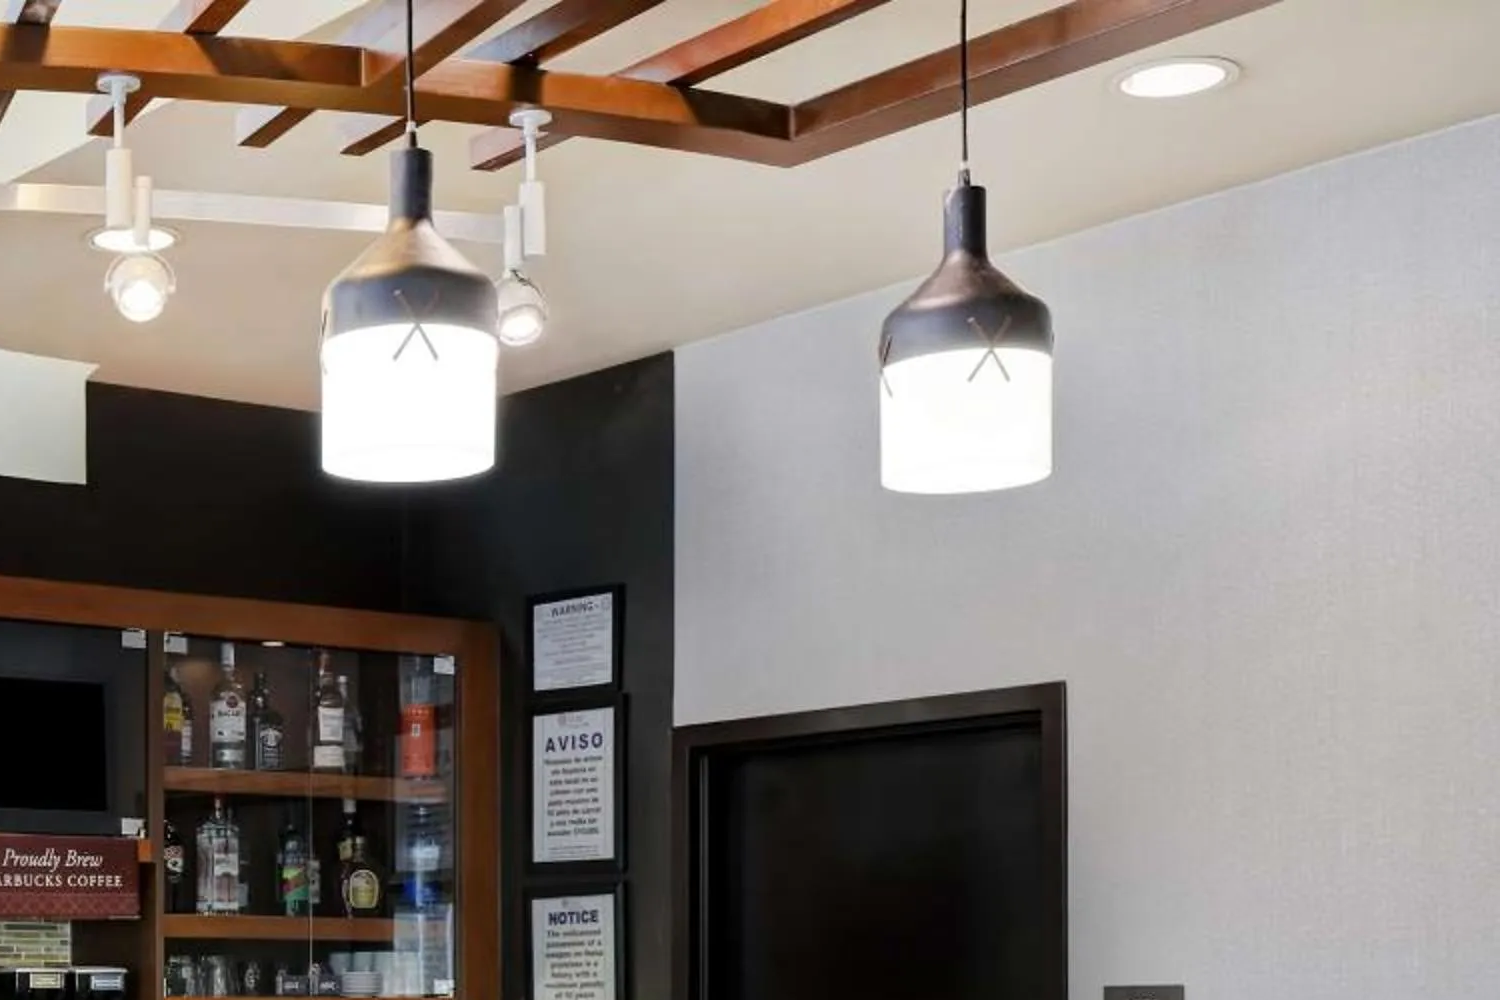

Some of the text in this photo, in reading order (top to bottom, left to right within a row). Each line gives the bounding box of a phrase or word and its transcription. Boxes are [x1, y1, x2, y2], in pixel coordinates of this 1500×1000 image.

[545, 732, 604, 753] AVISO
[2, 848, 61, 873] Proudly
[65, 850, 103, 867] Brew
[67, 875, 122, 887] COFFEE
[548, 909, 599, 926] NOTICE
